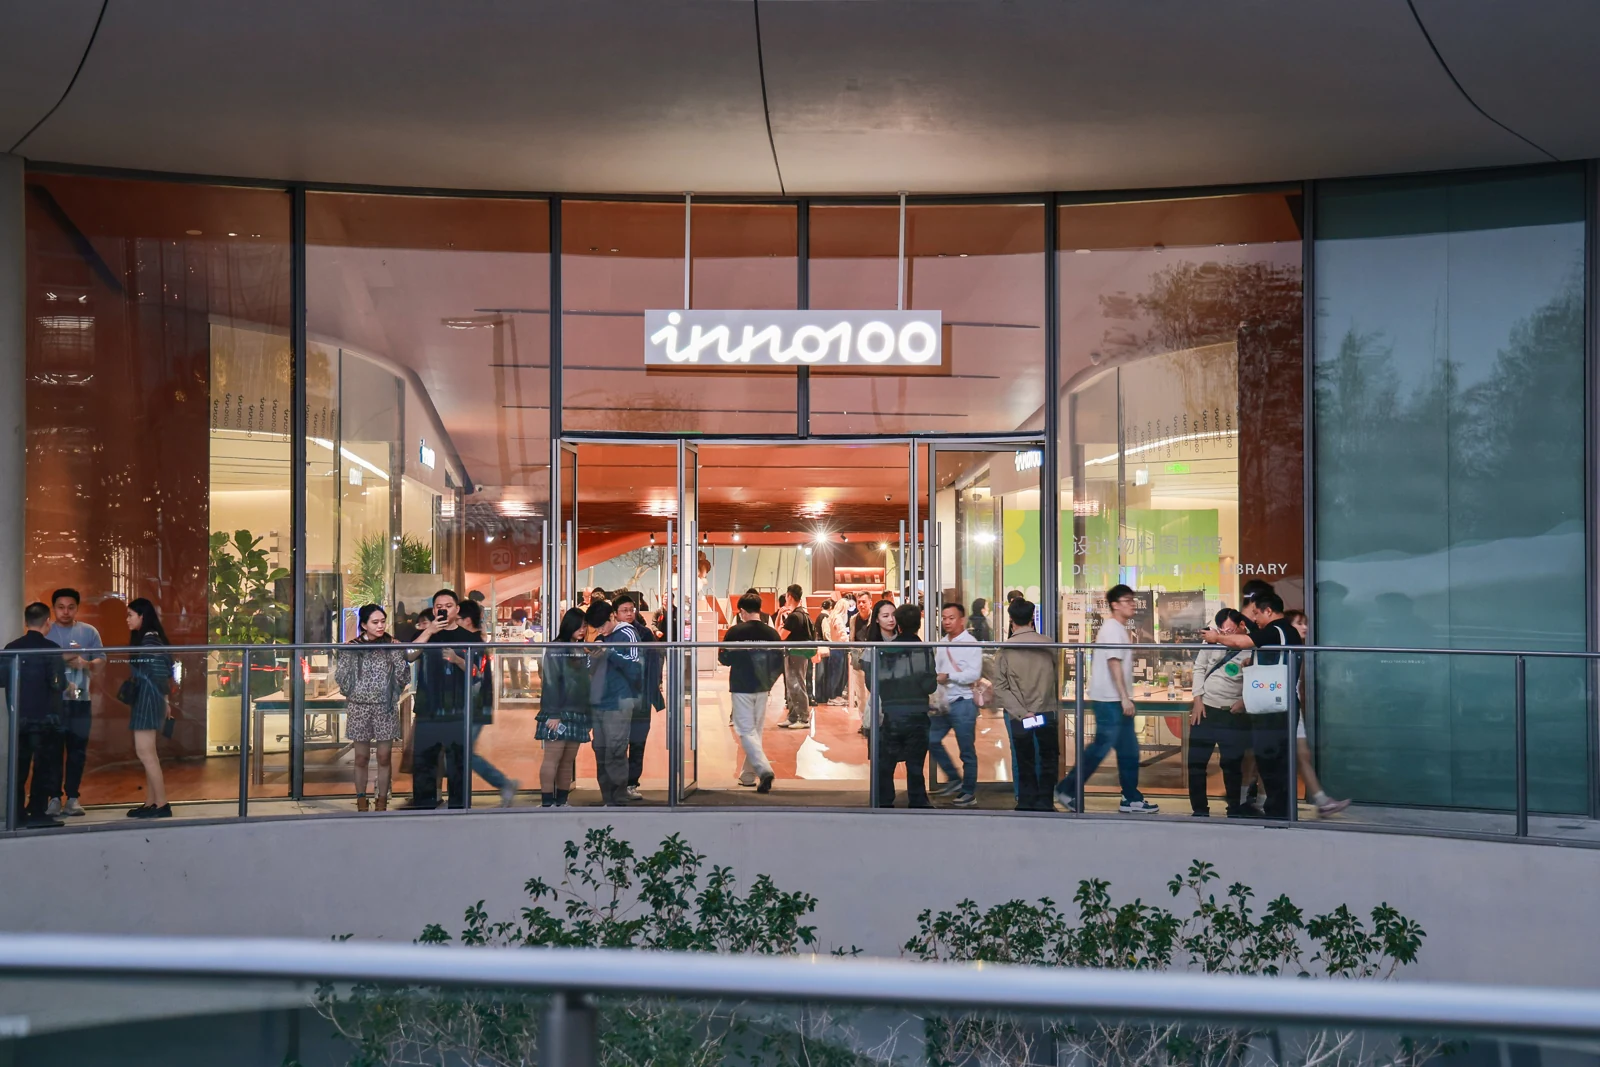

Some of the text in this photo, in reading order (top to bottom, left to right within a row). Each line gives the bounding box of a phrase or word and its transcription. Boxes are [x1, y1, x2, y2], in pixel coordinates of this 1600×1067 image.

[650, 311, 936, 363] inno100
[1072, 535, 1223, 556] 设计物料图书馆
[1072, 563, 1288, 575] DESIGN MATERIAL LIBRARY
[1251, 680, 1282, 692] Google
